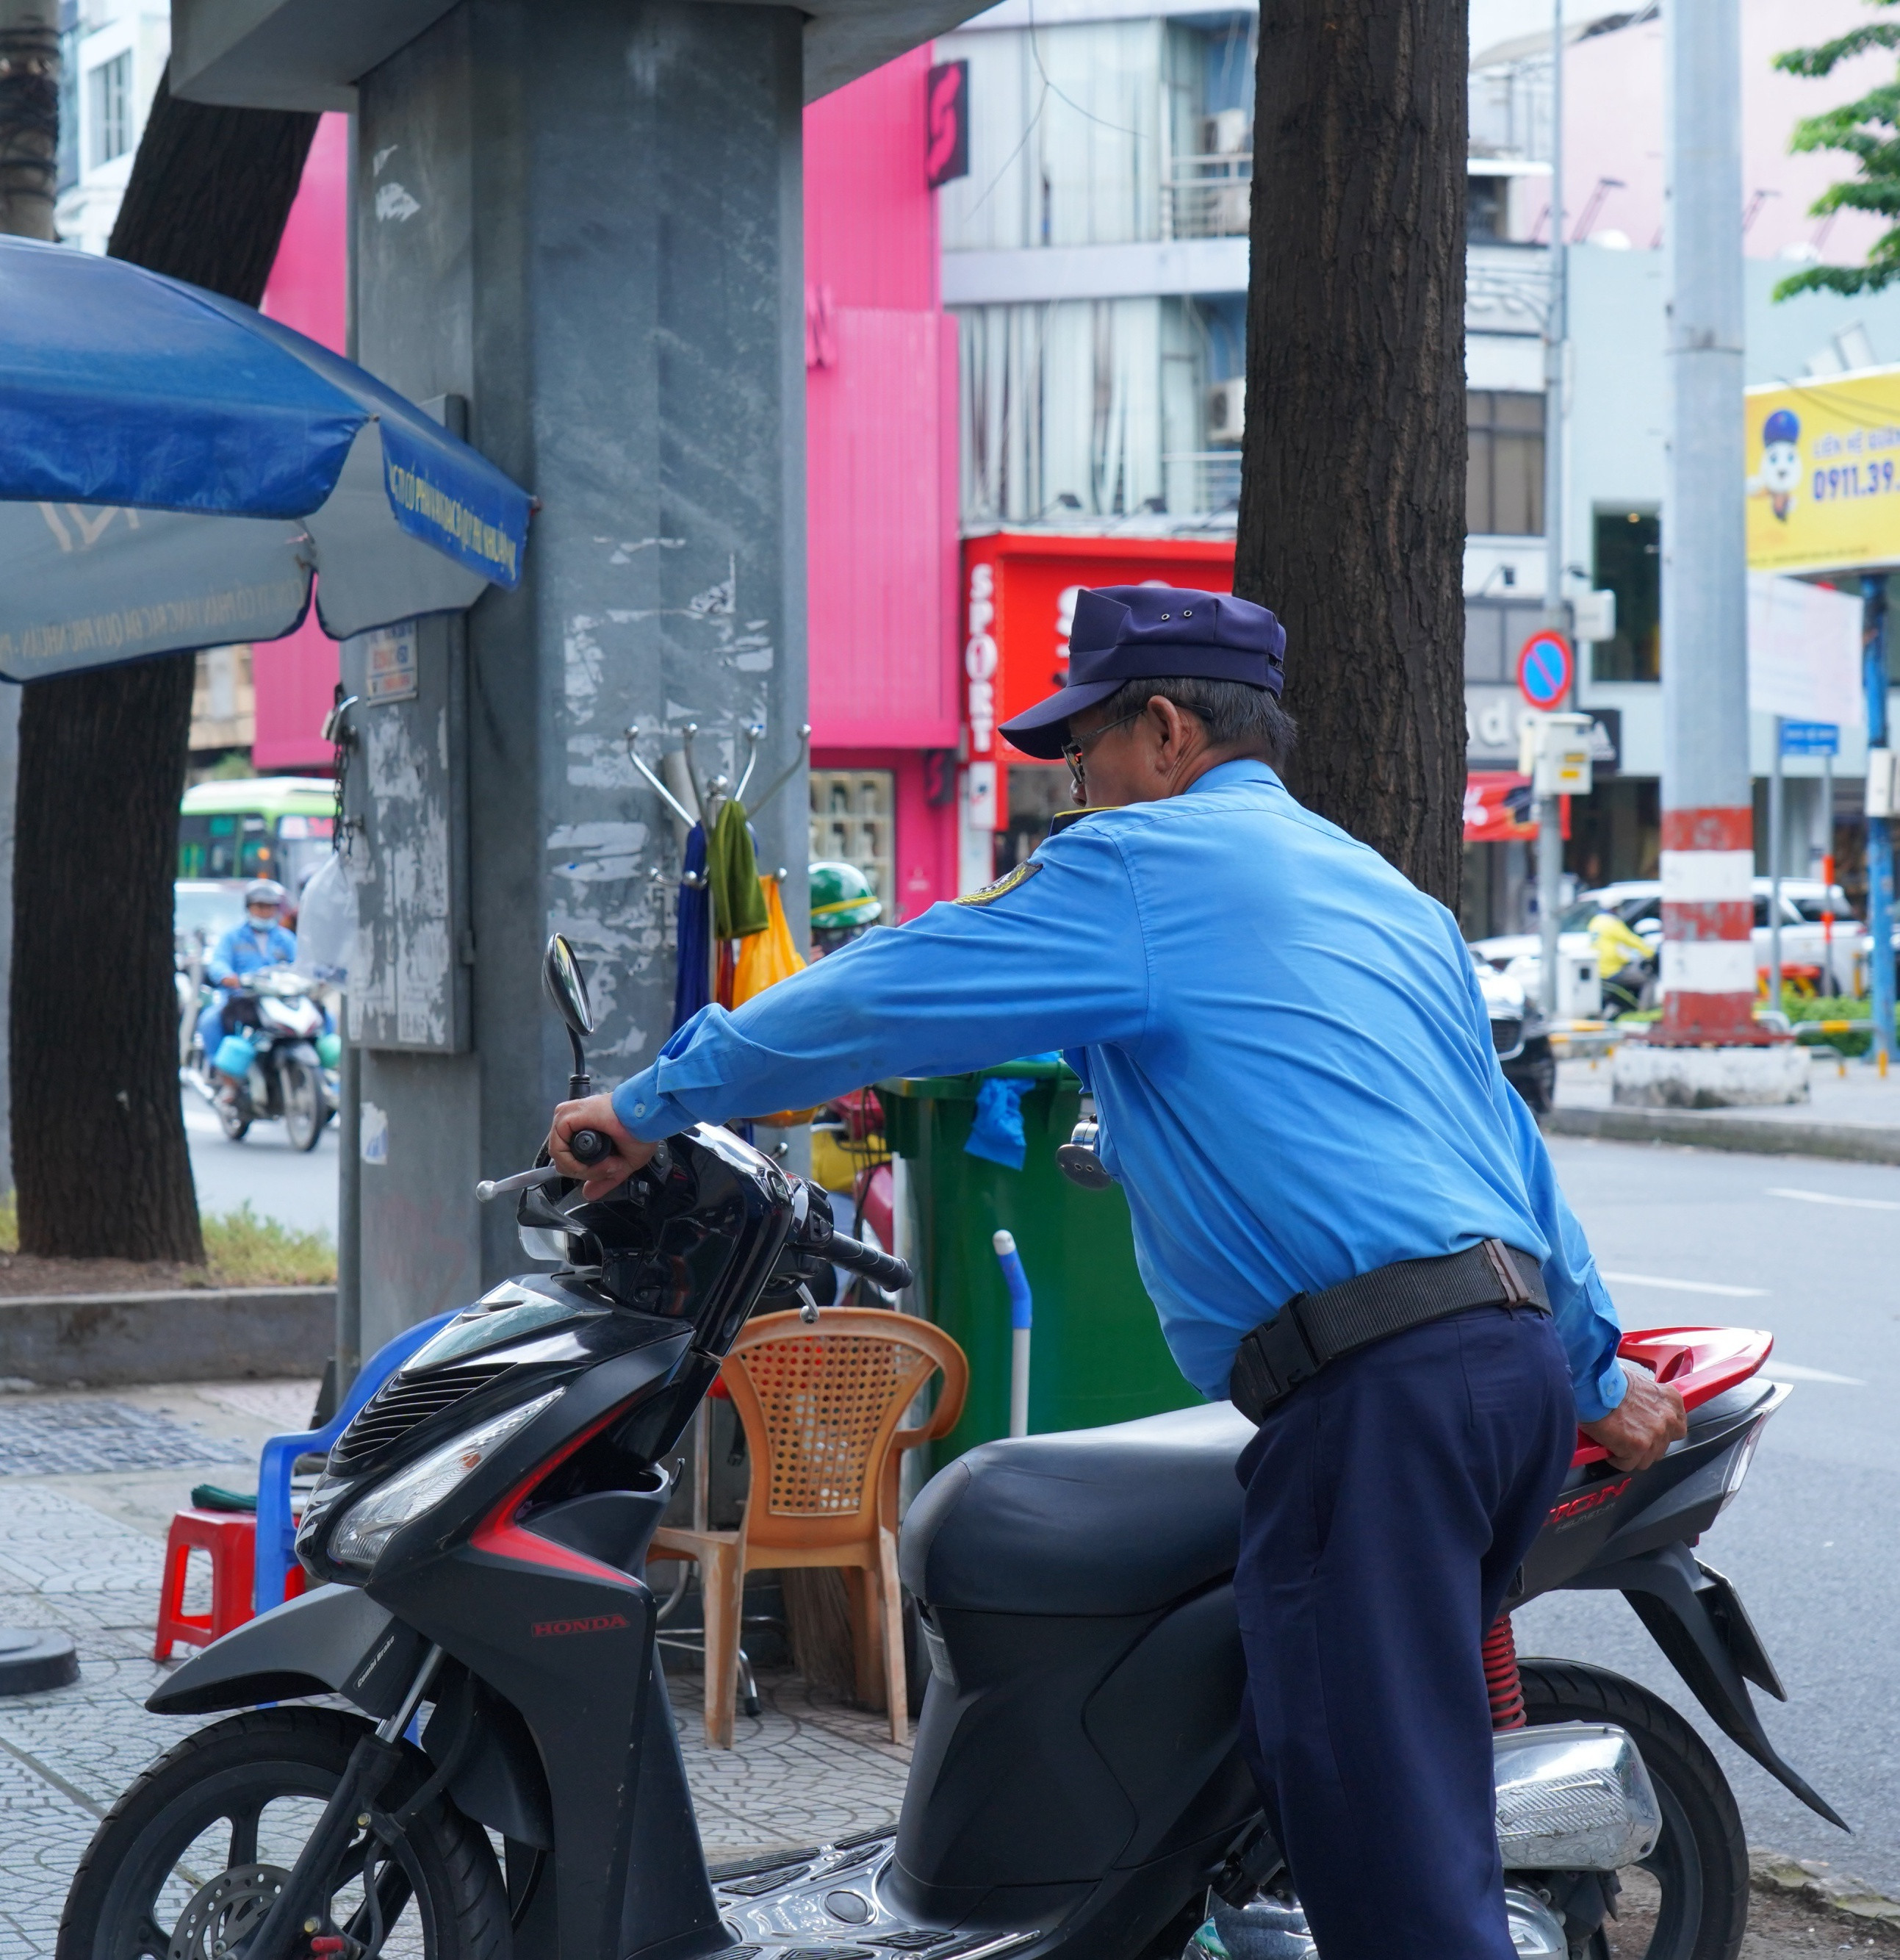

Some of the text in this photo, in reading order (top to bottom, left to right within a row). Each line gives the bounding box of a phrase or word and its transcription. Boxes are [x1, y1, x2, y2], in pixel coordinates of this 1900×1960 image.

[965, 563, 998, 753] SPORT
[533, 1615, 630, 1636] HONDA
[358, 1636, 395, 1688] Combi Brake
